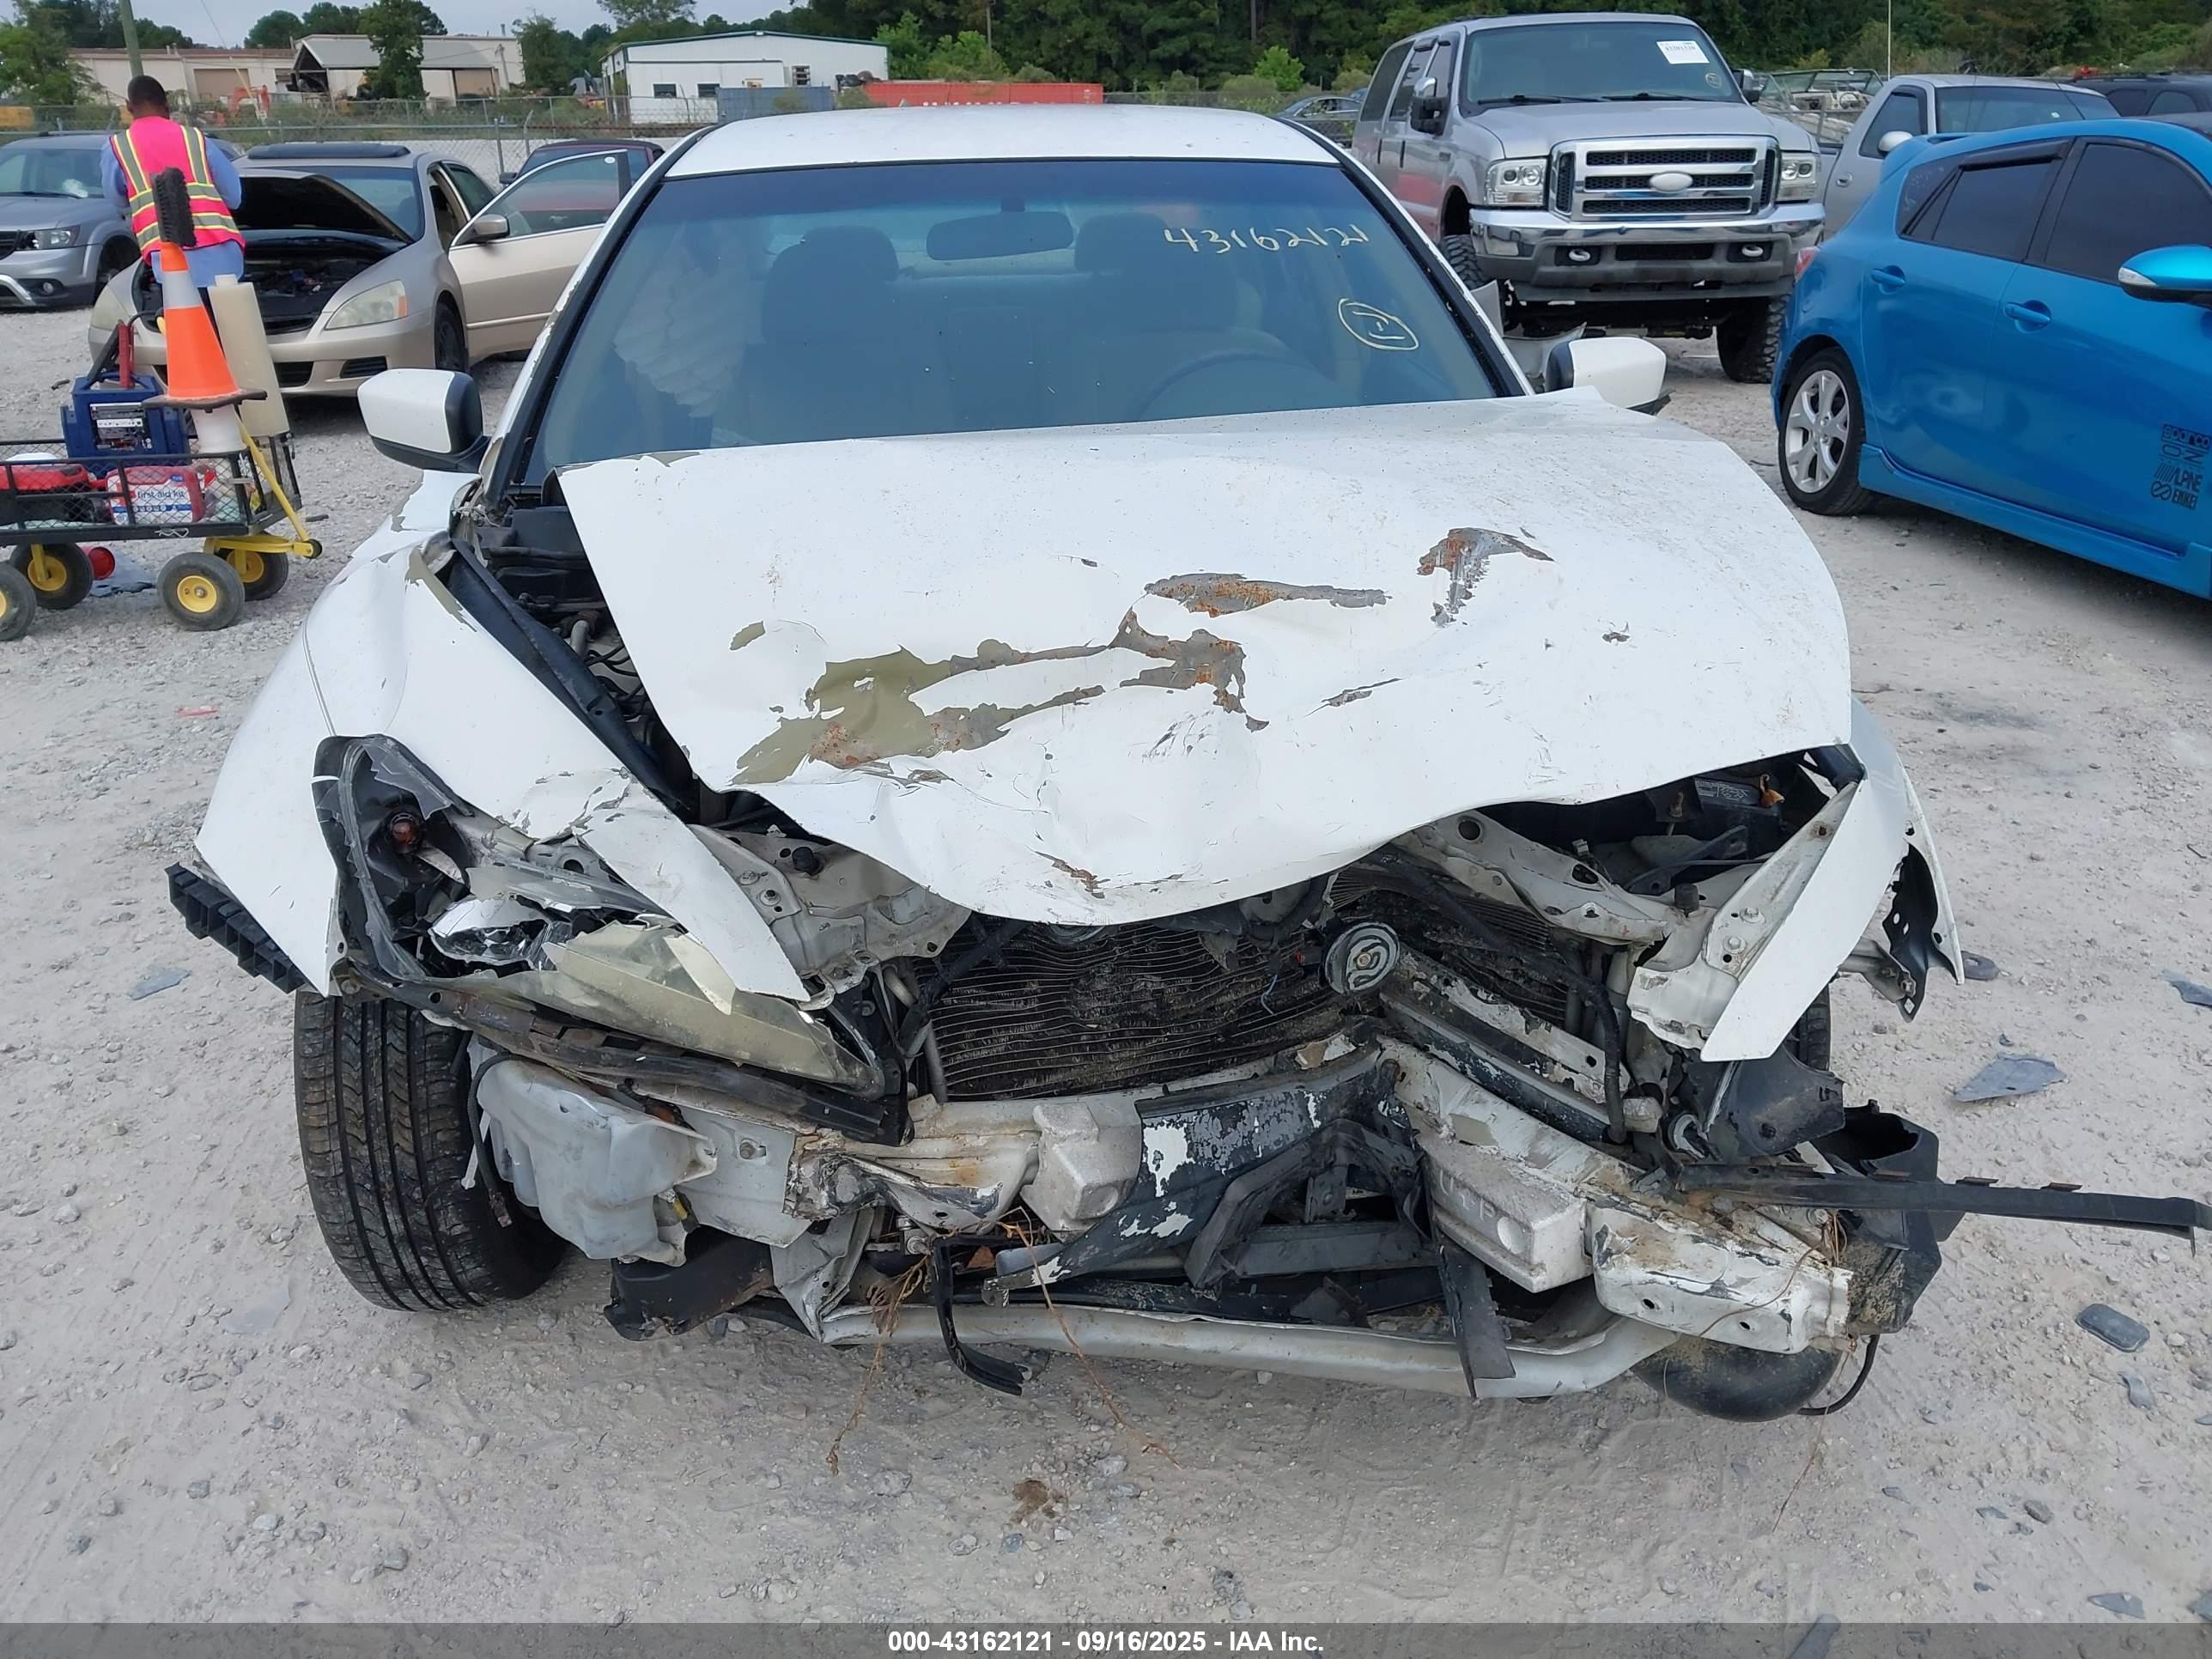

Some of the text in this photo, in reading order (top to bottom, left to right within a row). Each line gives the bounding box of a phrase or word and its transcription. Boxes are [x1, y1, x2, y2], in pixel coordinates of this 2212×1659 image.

[1164, 223, 1370, 253] 43162121
[137, 489, 185, 499] first aid kit
